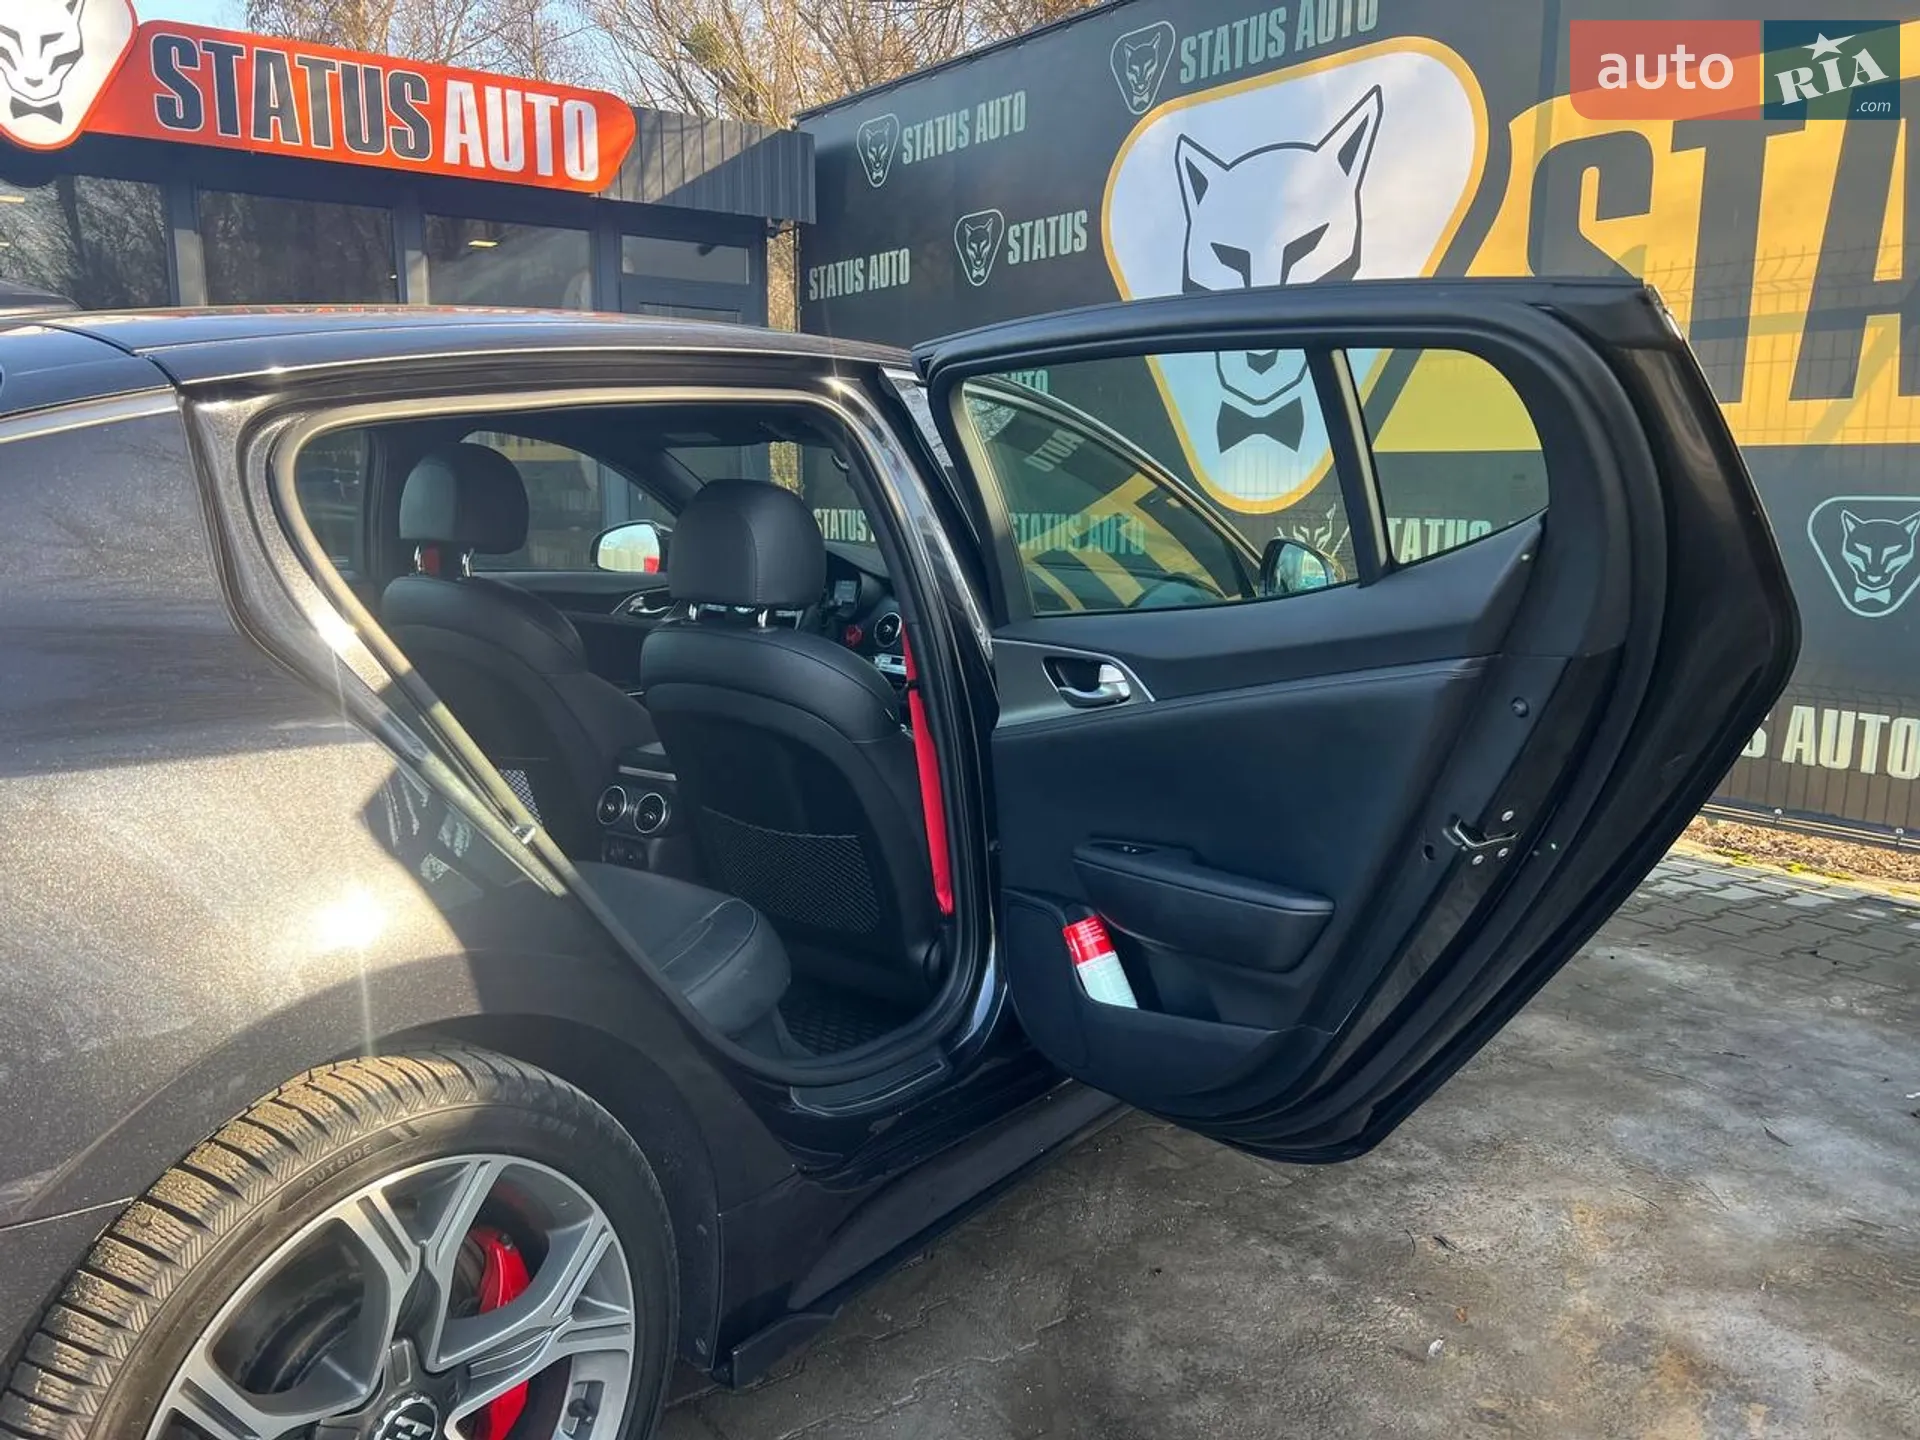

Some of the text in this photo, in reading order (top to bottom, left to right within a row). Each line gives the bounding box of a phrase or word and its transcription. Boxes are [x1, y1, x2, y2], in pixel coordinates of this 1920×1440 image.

[1180, 7, 1287, 84] STATUS
[151, 32, 599, 182] STATUS AUTO
[902, 90, 1026, 165] STATUS AUTO
[1007, 210, 1088, 265] STATUS
[808, 247, 910, 301] STATUS AUTO
[1087, 513, 1146, 555] AUTO
[1781, 705, 1920, 780] AUTO
[304, 1143, 374, 1189] OUTSIDE
